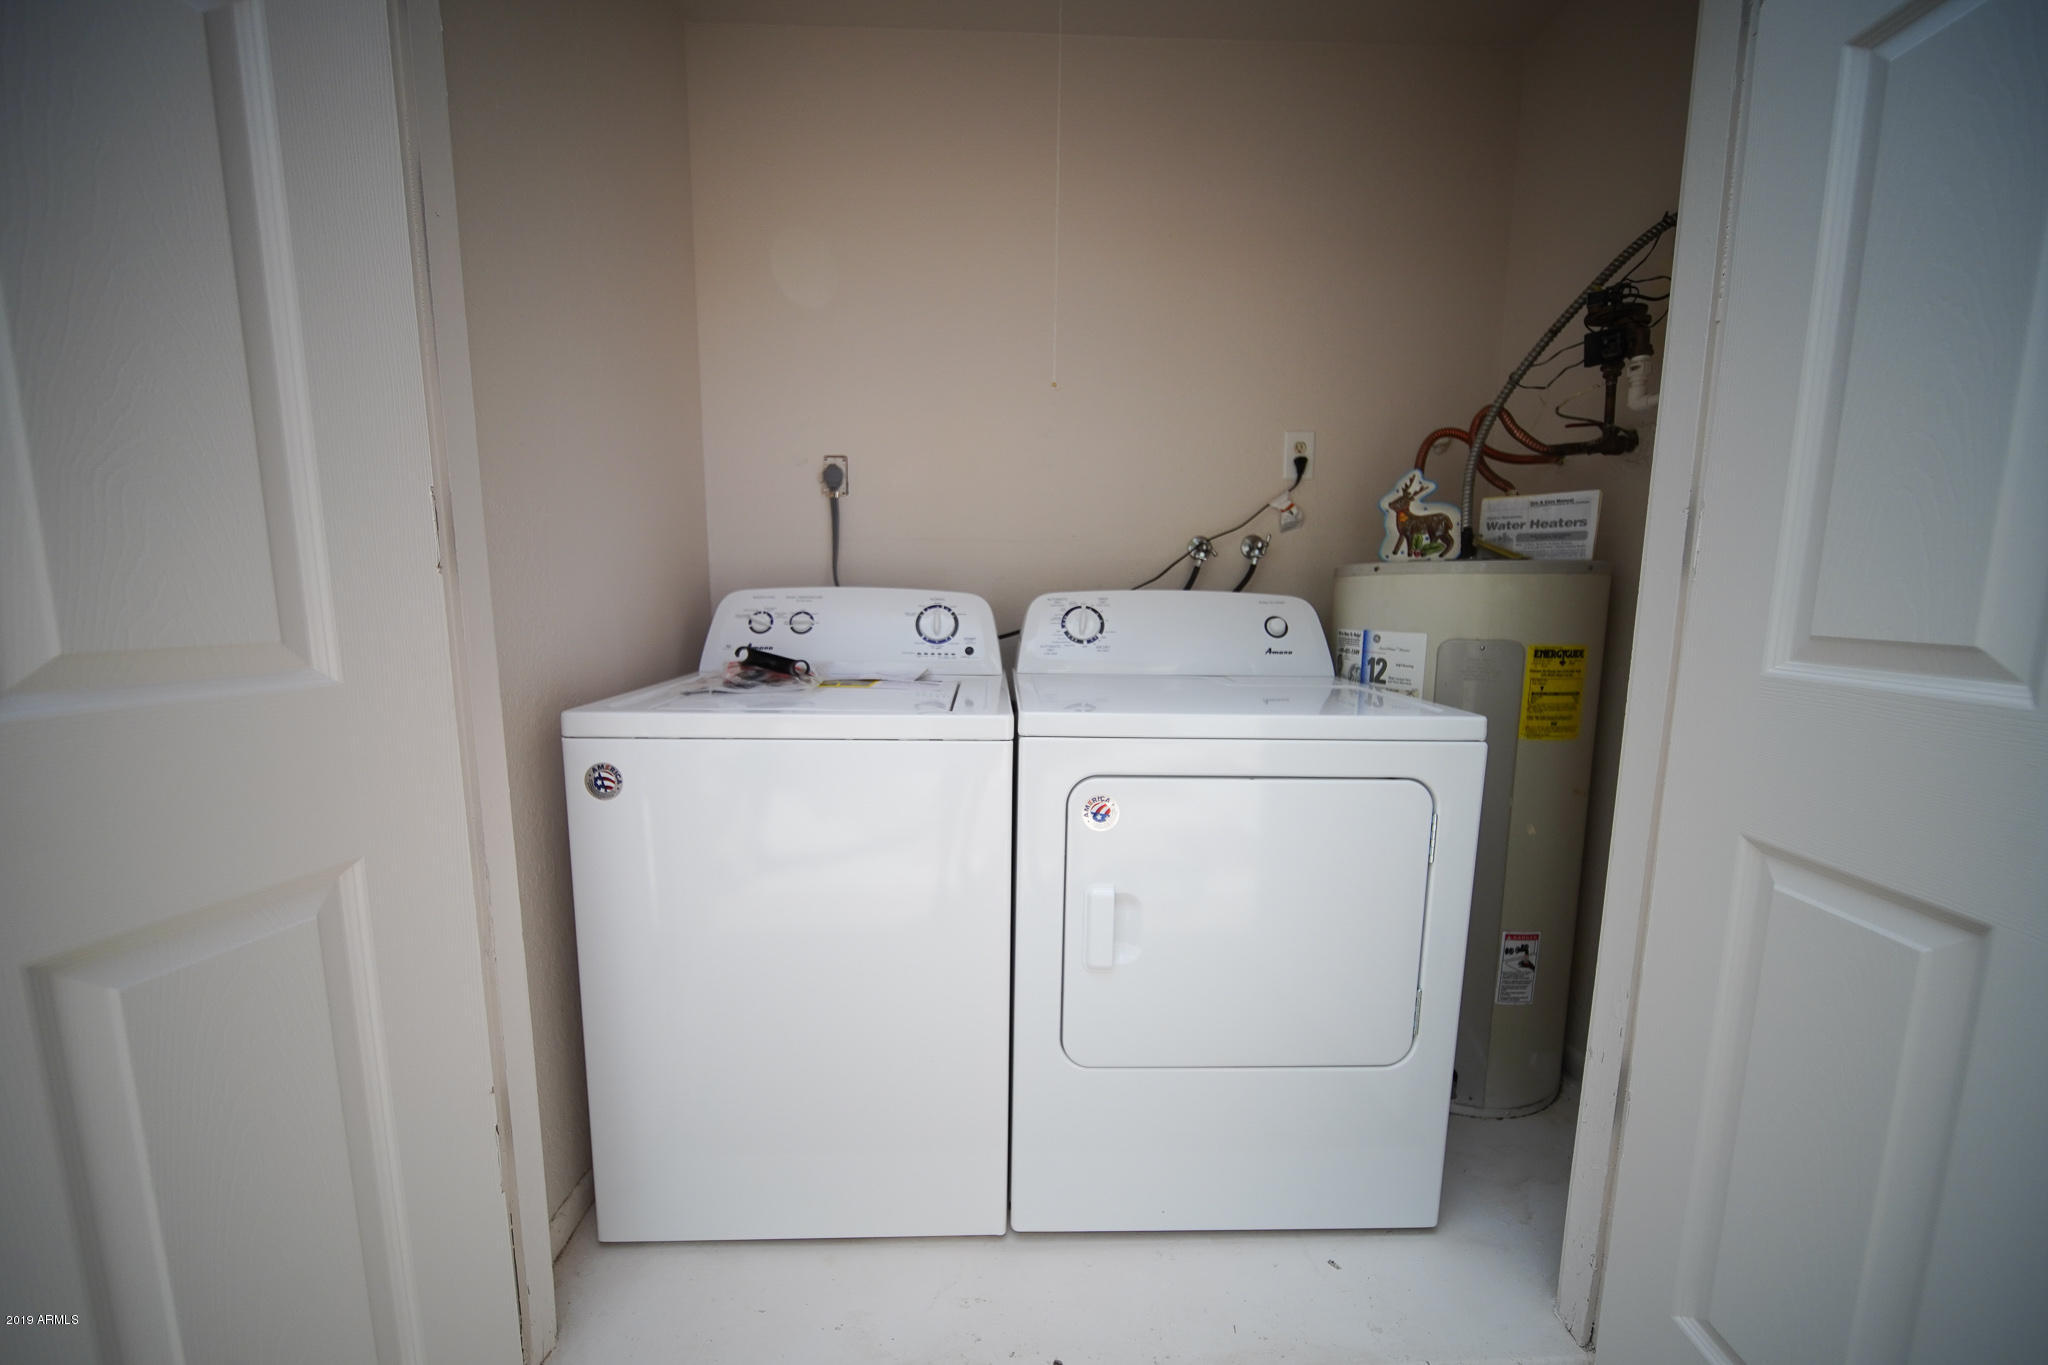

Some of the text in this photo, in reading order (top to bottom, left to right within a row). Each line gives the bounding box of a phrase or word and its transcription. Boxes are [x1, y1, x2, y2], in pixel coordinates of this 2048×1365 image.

[1486, 518, 1588, 531] Water Heaters
[1265, 647, 1293, 655] Amana
[1367, 656, 1388, 685] 12
[592, 763, 623, 785] AMERICA
[1084, 796, 1111, 818] AMERICA
